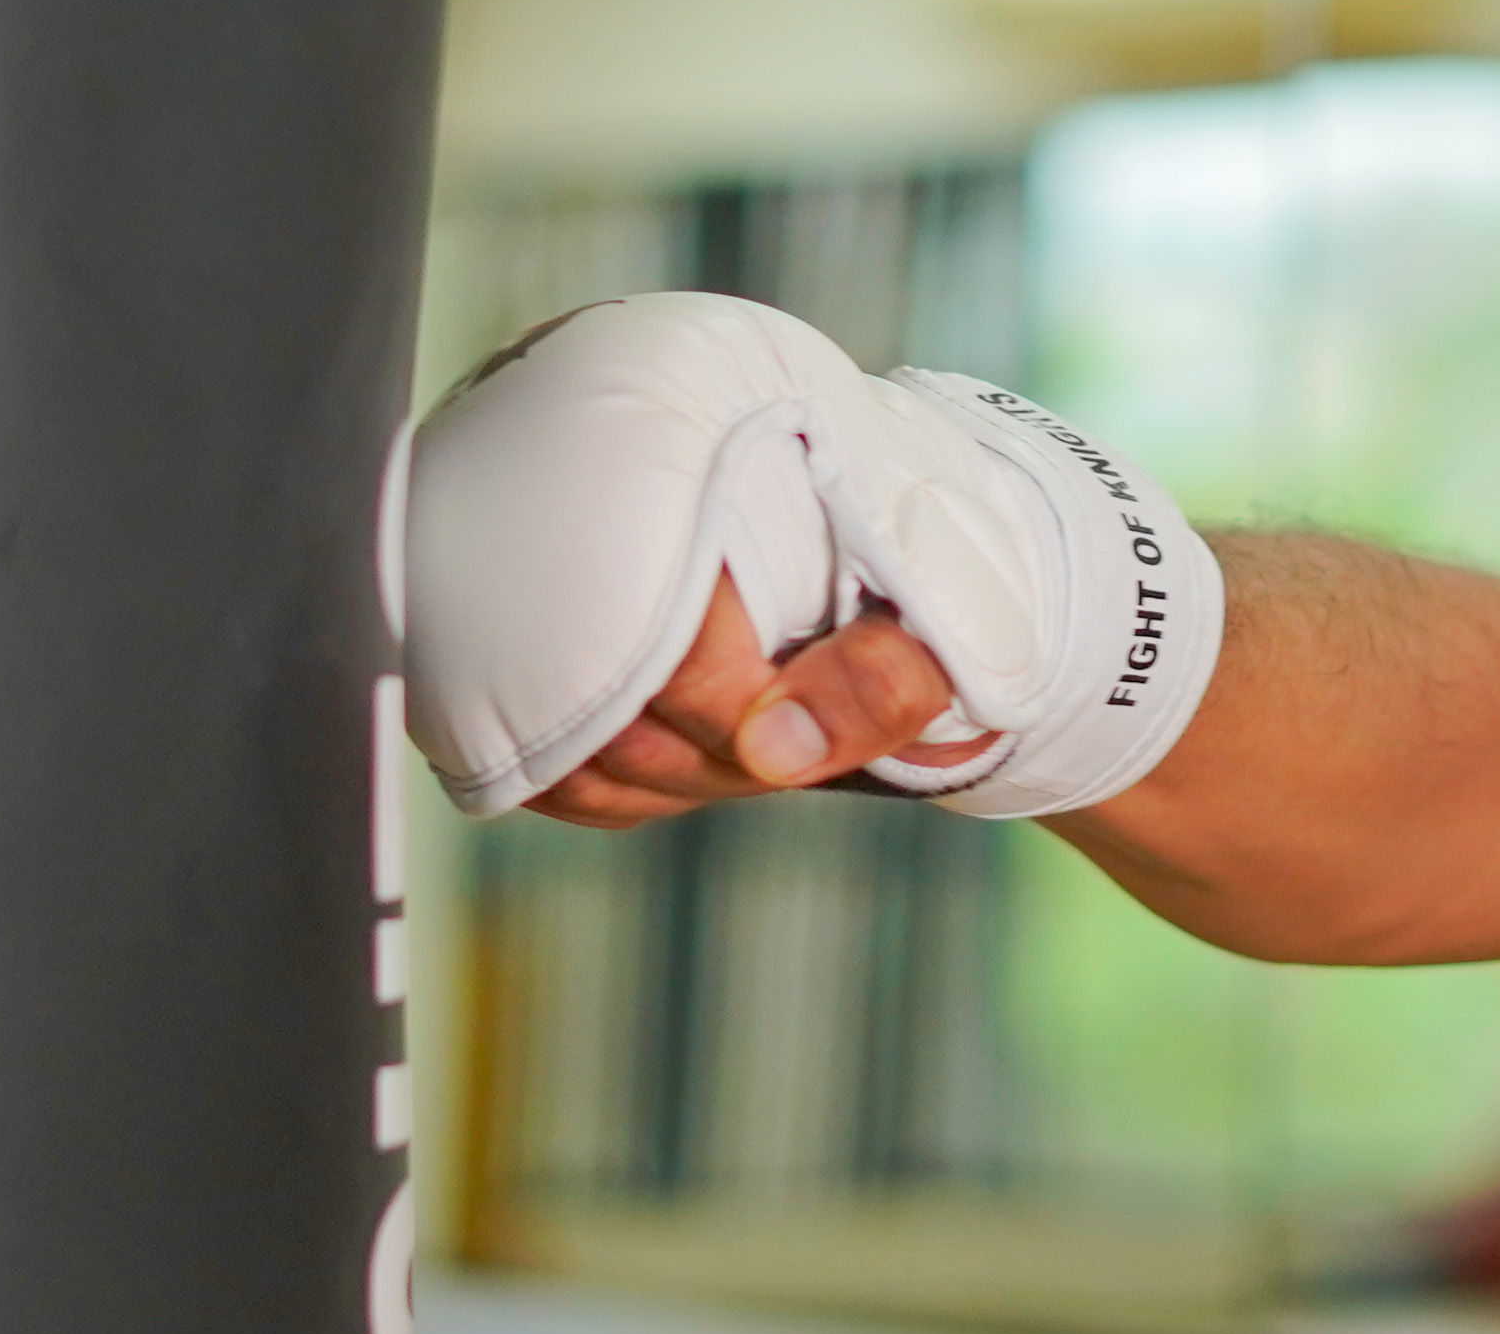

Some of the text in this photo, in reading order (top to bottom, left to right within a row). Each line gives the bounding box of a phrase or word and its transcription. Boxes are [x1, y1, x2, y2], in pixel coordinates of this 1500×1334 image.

[975, 392, 1169, 707] FIGHT OF KNIGHTS
